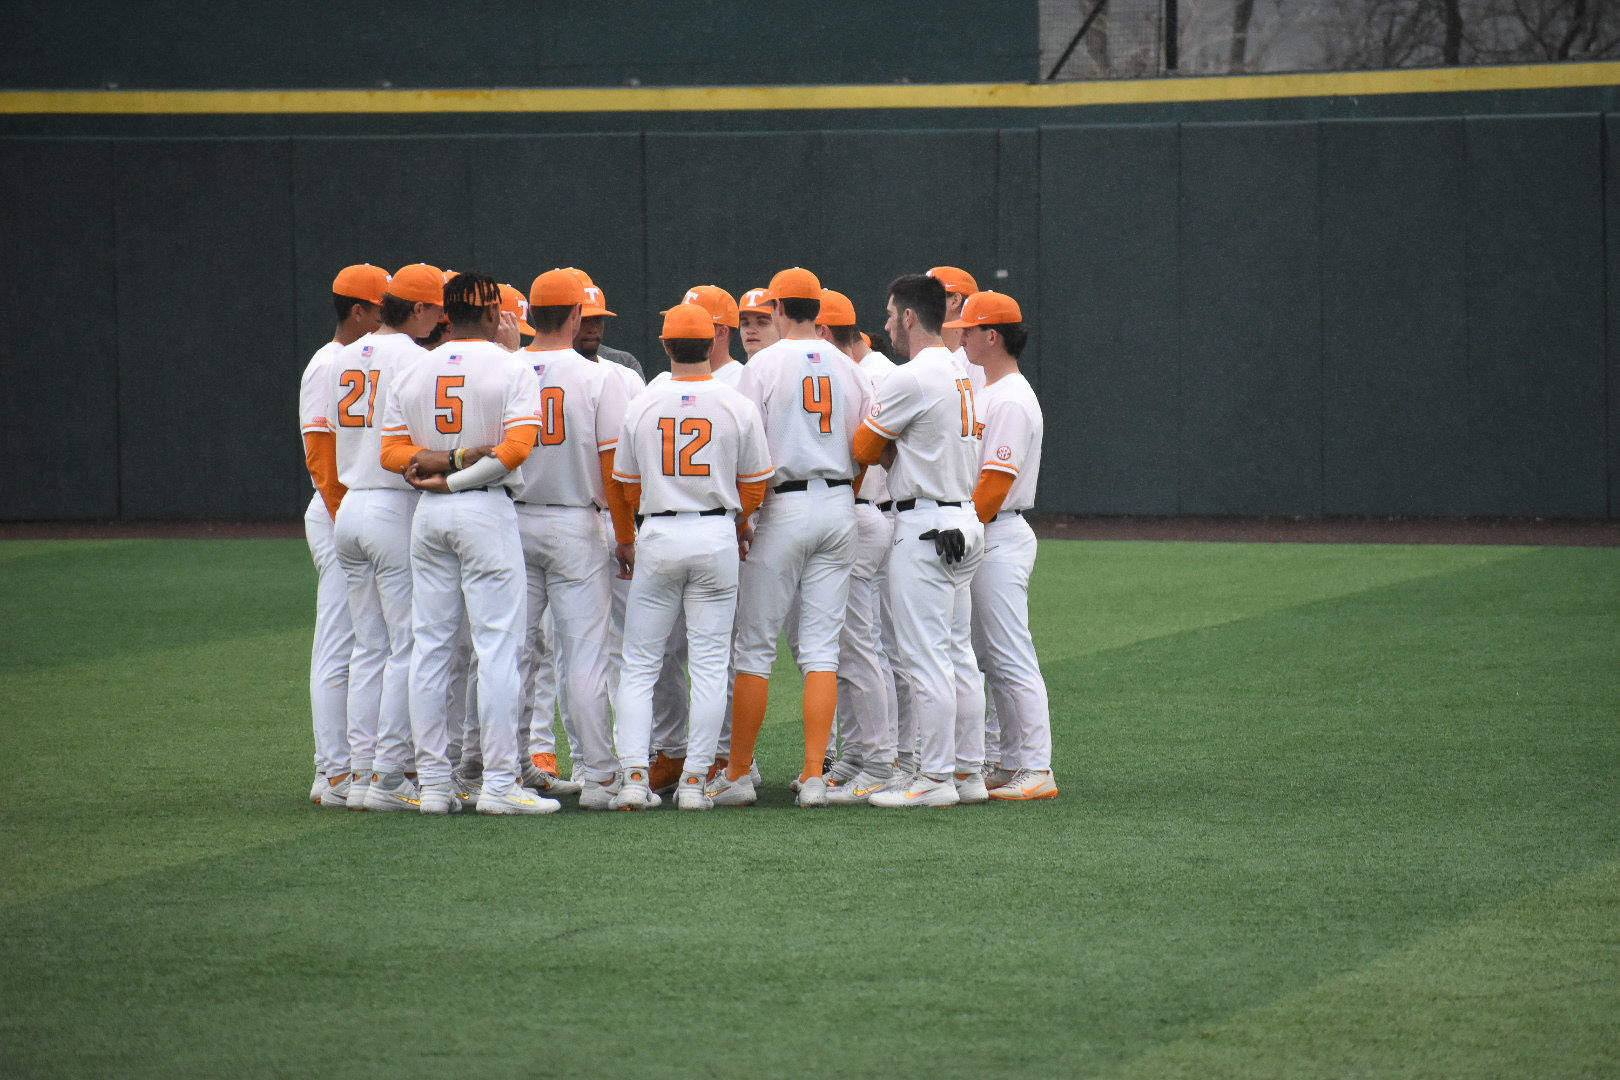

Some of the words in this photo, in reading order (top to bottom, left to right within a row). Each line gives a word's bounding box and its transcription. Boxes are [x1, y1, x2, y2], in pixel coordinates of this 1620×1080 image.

[745, 290, 764, 307] T
[337, 369, 381, 427] 21
[434, 375, 465, 434] 5
[534, 386, 566, 446] 0
[802, 376, 833, 433] 4
[657, 417, 712, 476] 12
